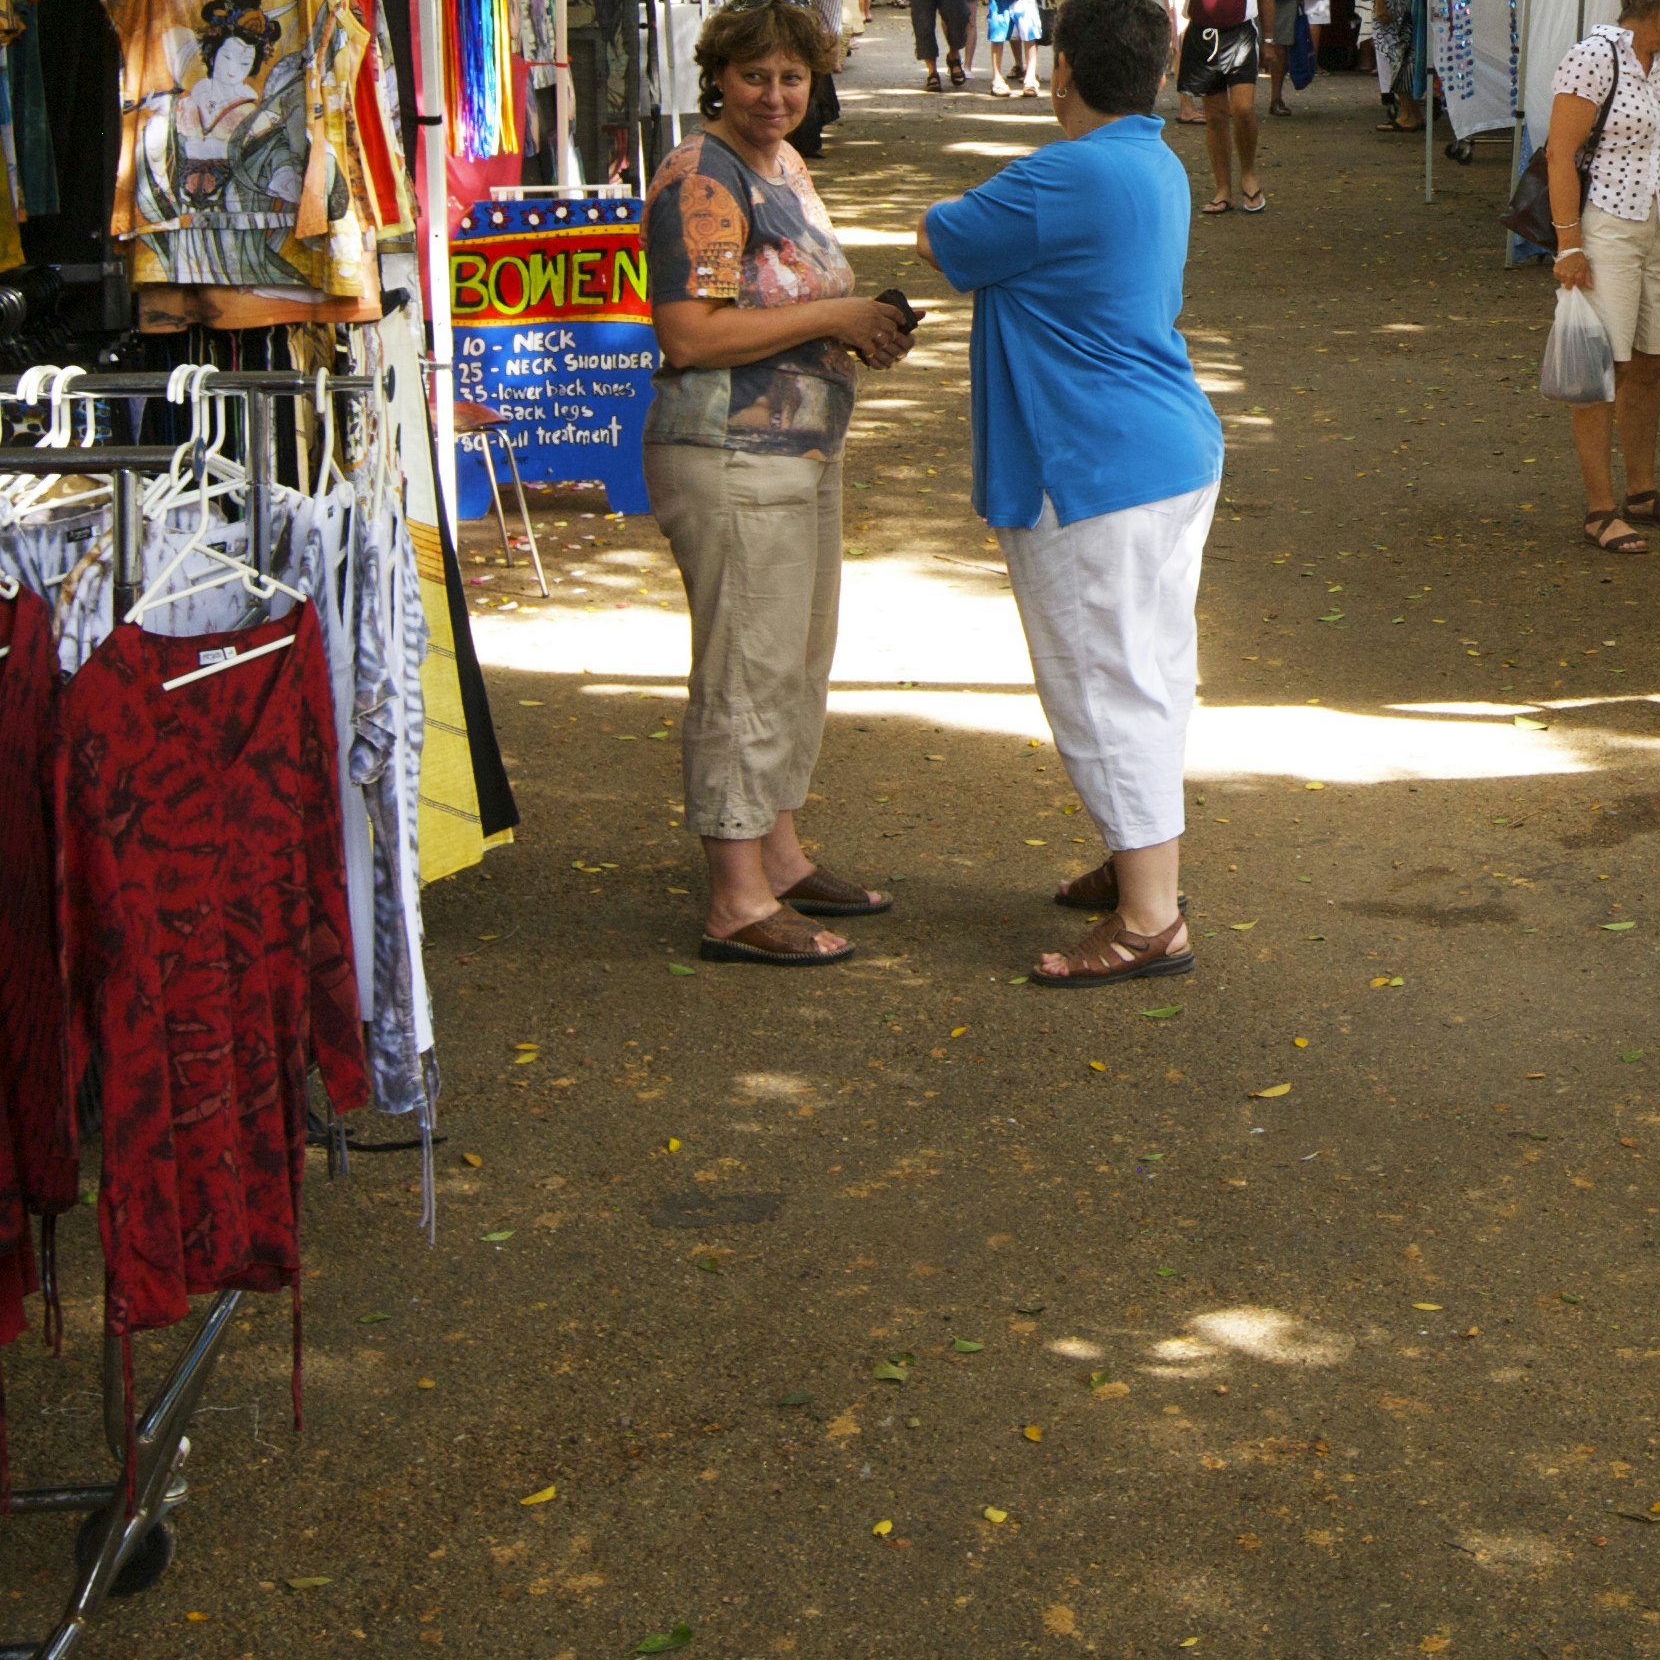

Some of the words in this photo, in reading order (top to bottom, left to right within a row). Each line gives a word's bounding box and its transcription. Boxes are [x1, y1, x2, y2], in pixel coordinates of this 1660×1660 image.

[450, 250, 649, 315] BOWEN
[463, 336, 486, 356] 10
[513, 329, 576, 354] NECK
[458, 361, 483, 384] 25
[505, 357, 557, 376] NECK
[564, 351, 653, 372] SHOULDER
[545, 378, 587, 398] back
[554, 401, 594, 421] legs
[535, 415, 623, 448] treatment
